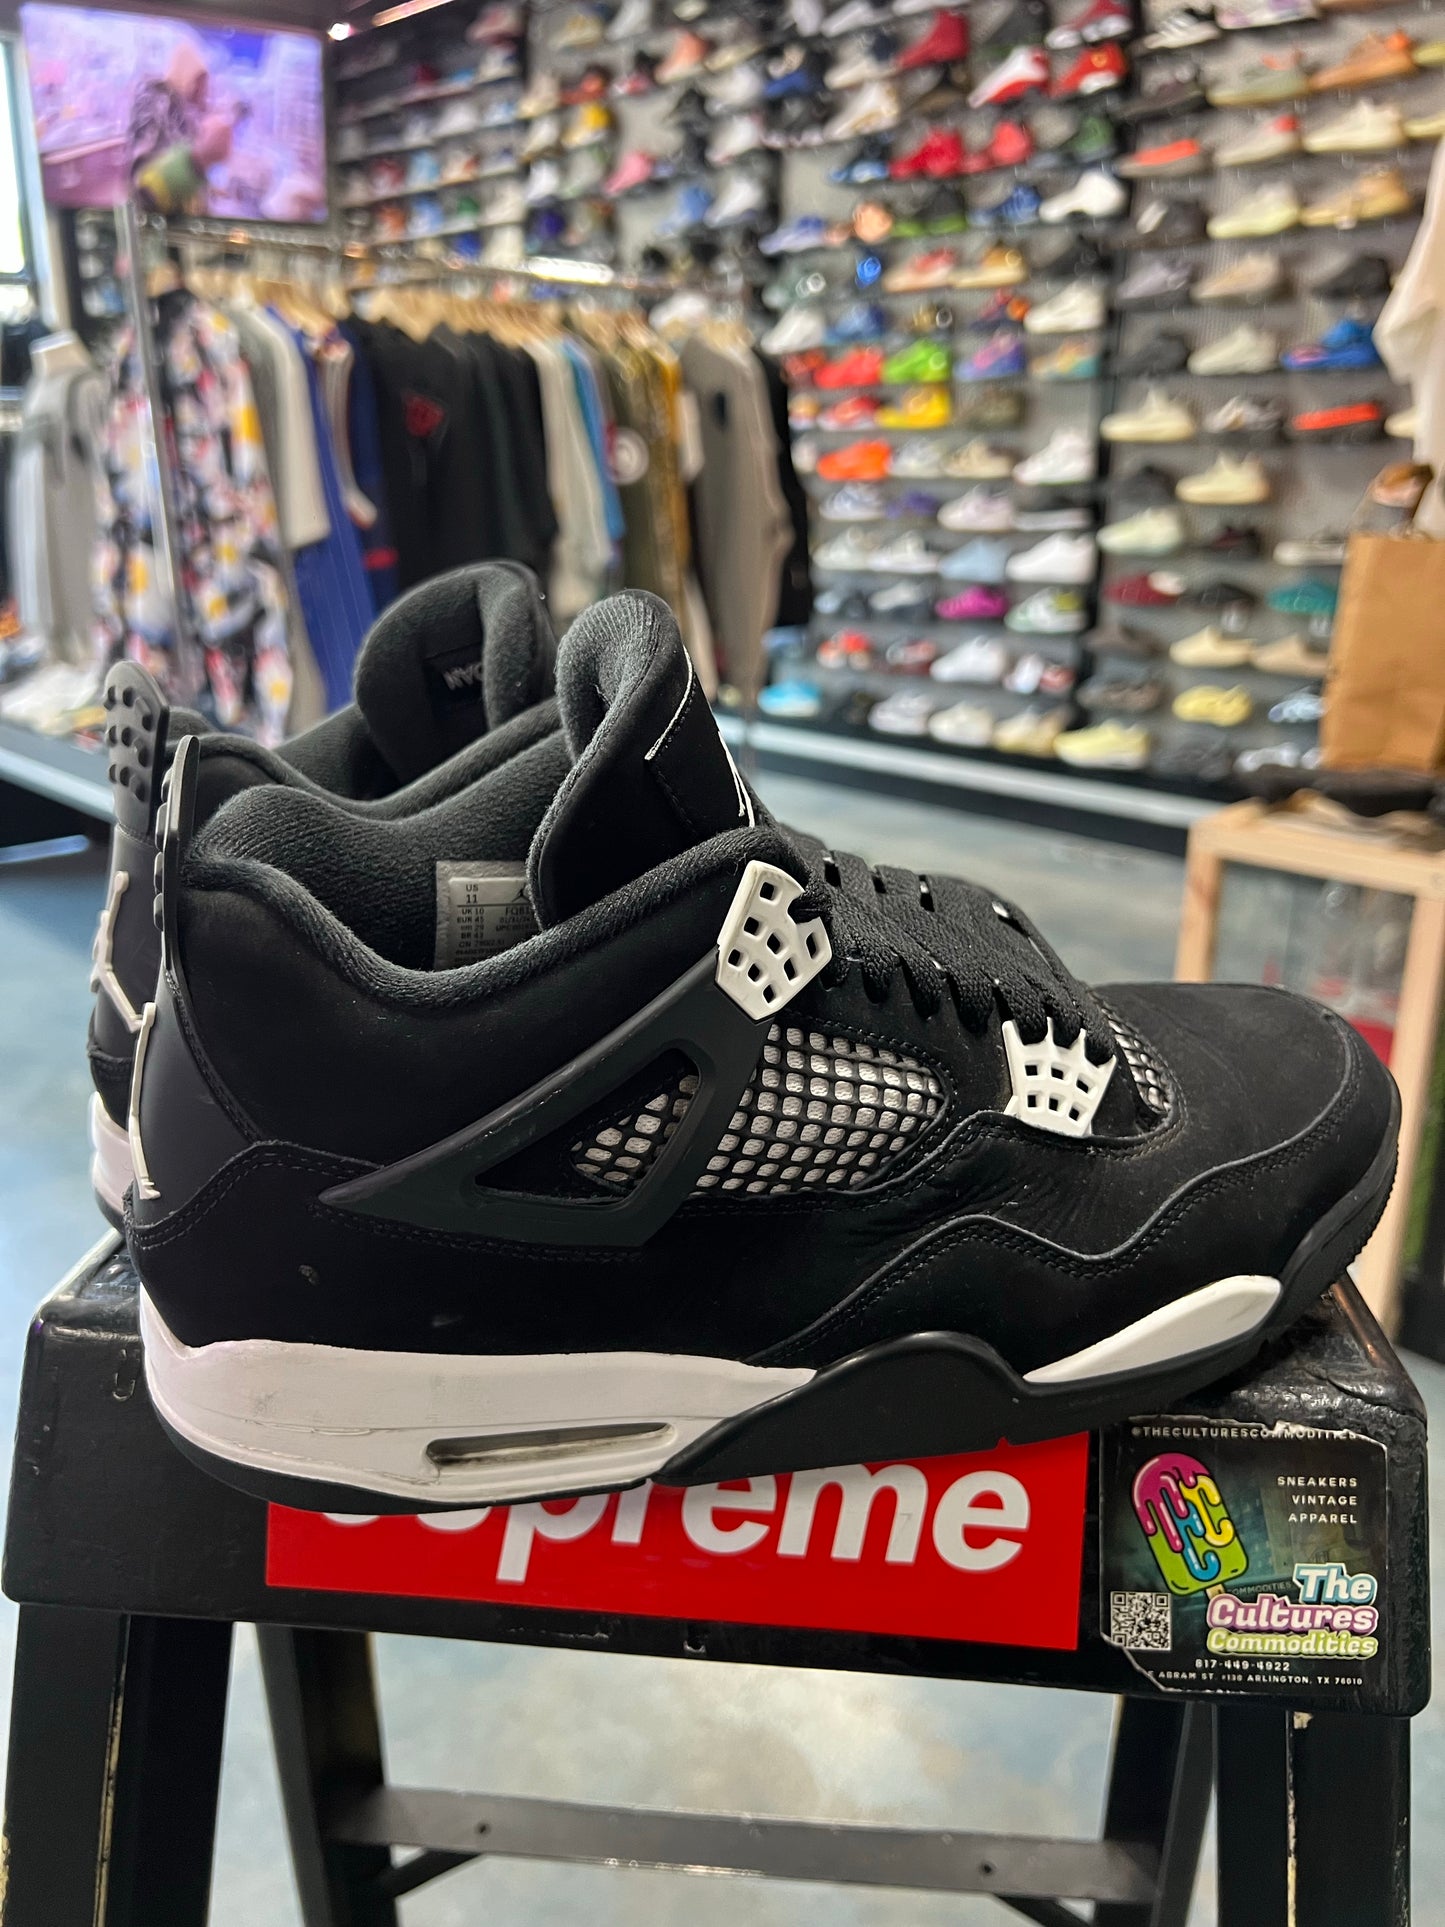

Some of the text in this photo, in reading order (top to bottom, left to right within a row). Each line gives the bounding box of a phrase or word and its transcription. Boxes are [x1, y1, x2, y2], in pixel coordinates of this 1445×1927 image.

[465, 883, 479, 892] US
[466, 894, 478, 904] 11
[461, 907, 485, 915] UK 10
[1277, 1476, 1358, 1487] SNEAKERS
[1292, 1495, 1358, 1506] VINTAGE
[1288, 1513, 1358, 1524] APPAREL
[321, 1465, 1031, 1585] preme
[1295, 1565, 1375, 1602] The
[1209, 1595, 1377, 1633] Cultures
[1209, 1628, 1377, 1657] Commodities
[1195, 1659, 1291, 1672] 817-449-4922
[1158, 1671, 1197, 1680] ABRAM
[1317, 1676, 1330, 1684] TX
[1334, 1677, 1363, 1685] 76010
